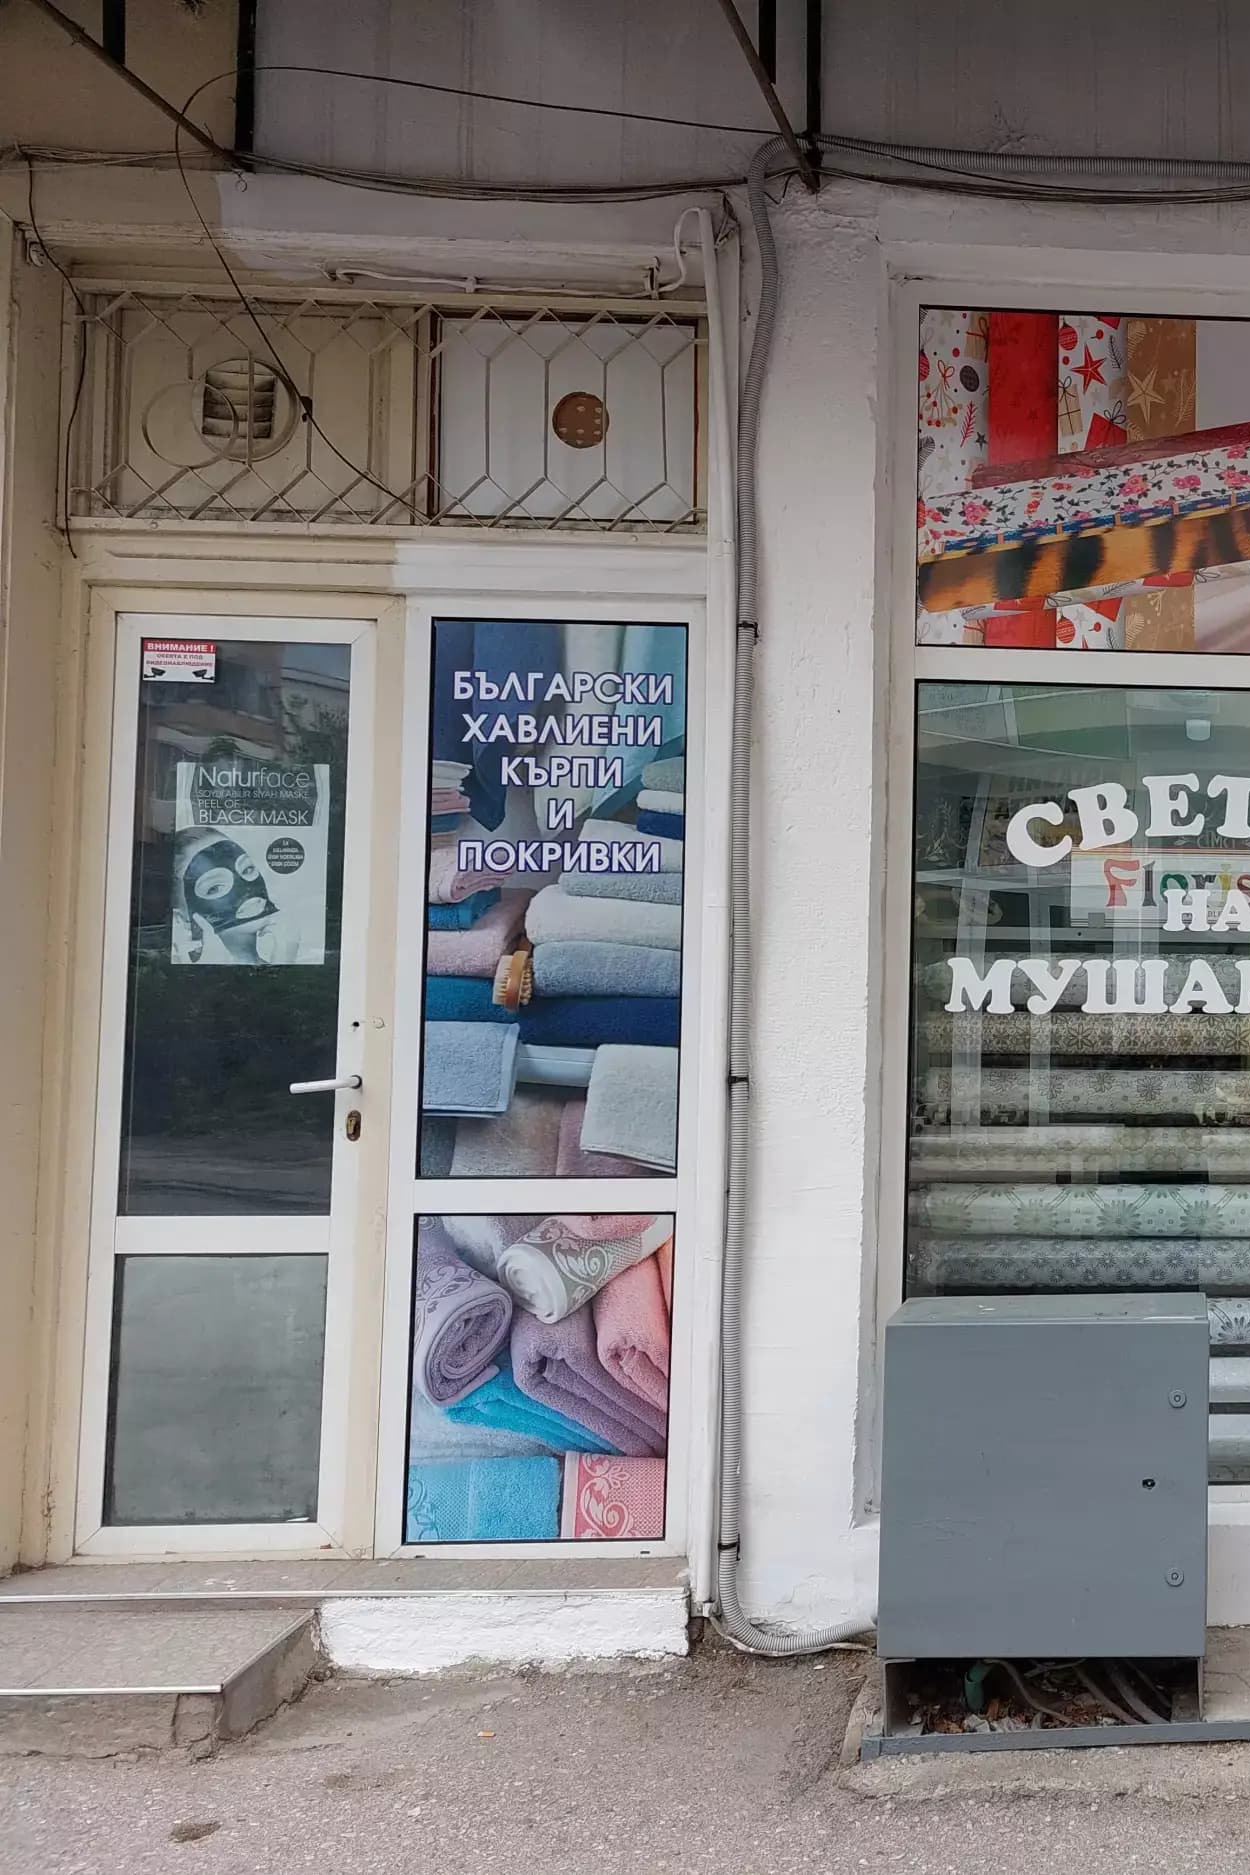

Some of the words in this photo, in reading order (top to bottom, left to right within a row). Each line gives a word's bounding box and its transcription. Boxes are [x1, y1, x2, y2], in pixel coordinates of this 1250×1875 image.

[147, 642, 208, 652] ВНИМАНИЕ
[453, 671, 674, 704] БЪЛГАРСКИ
[461, 713, 663, 746] ХАВЛИЕНИ
[199, 766, 310, 788] Naturface
[501, 756, 624, 788] КЪРПИ
[198, 799, 222, 809] PEEL
[199, 809, 255, 824] BLACK
[260, 810, 309, 825] MASK
[547, 798, 575, 830] И
[457, 840, 662, 873] ПОКРИВКИ
